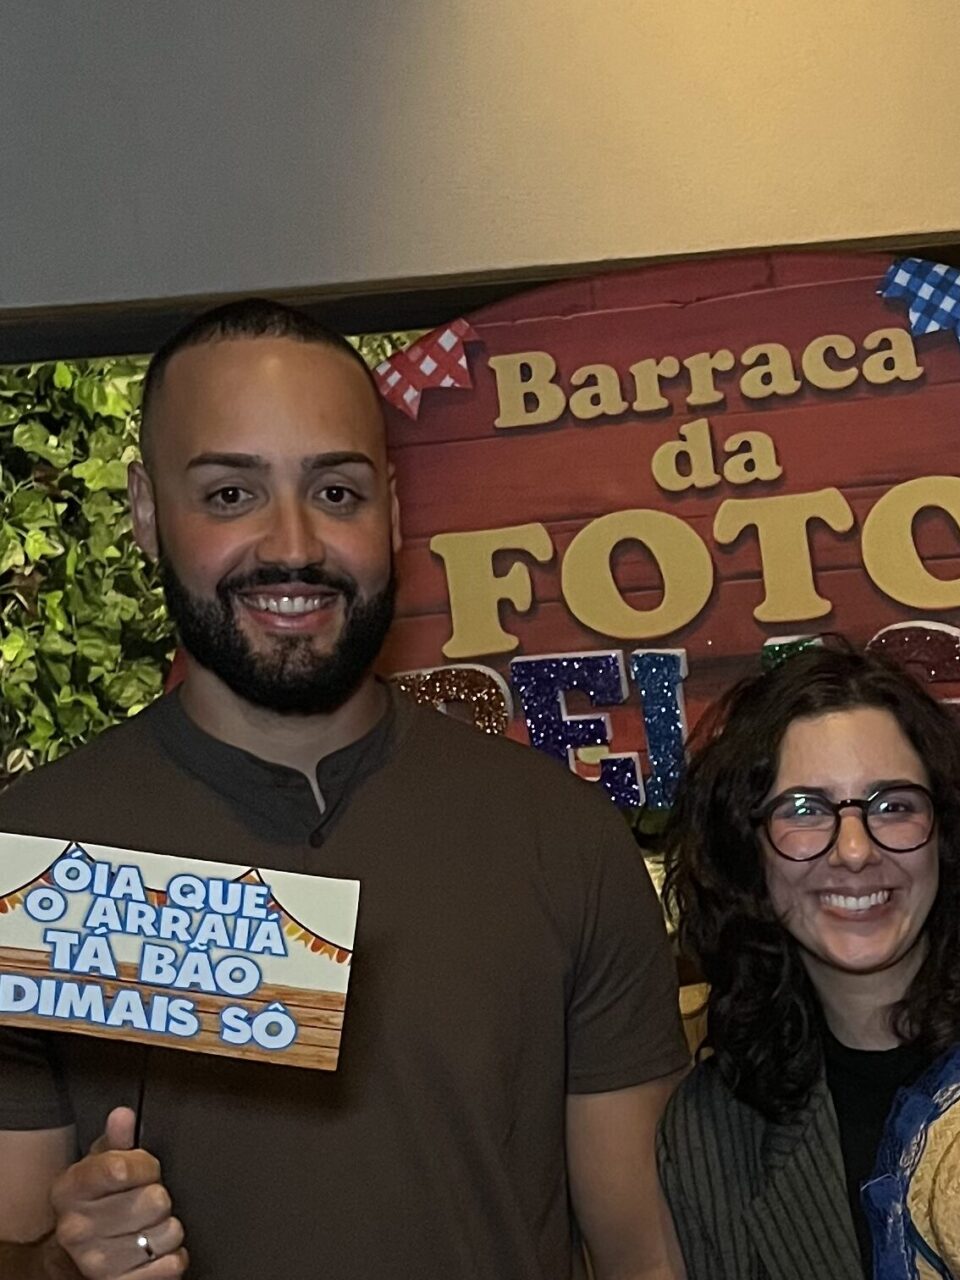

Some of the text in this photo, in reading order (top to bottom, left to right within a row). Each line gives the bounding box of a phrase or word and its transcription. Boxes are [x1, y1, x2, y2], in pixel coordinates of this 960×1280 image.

[488, 326, 923, 428] Barraca
[651, 418, 782, 492] da
[53, 849, 270, 920] ÓIA QUE
[25, 887, 288, 955] O ARRAIÁ
[45, 926, 261, 996] TÁ BÃO
[0, 974, 297, 1049] DIMAIS SÔ
